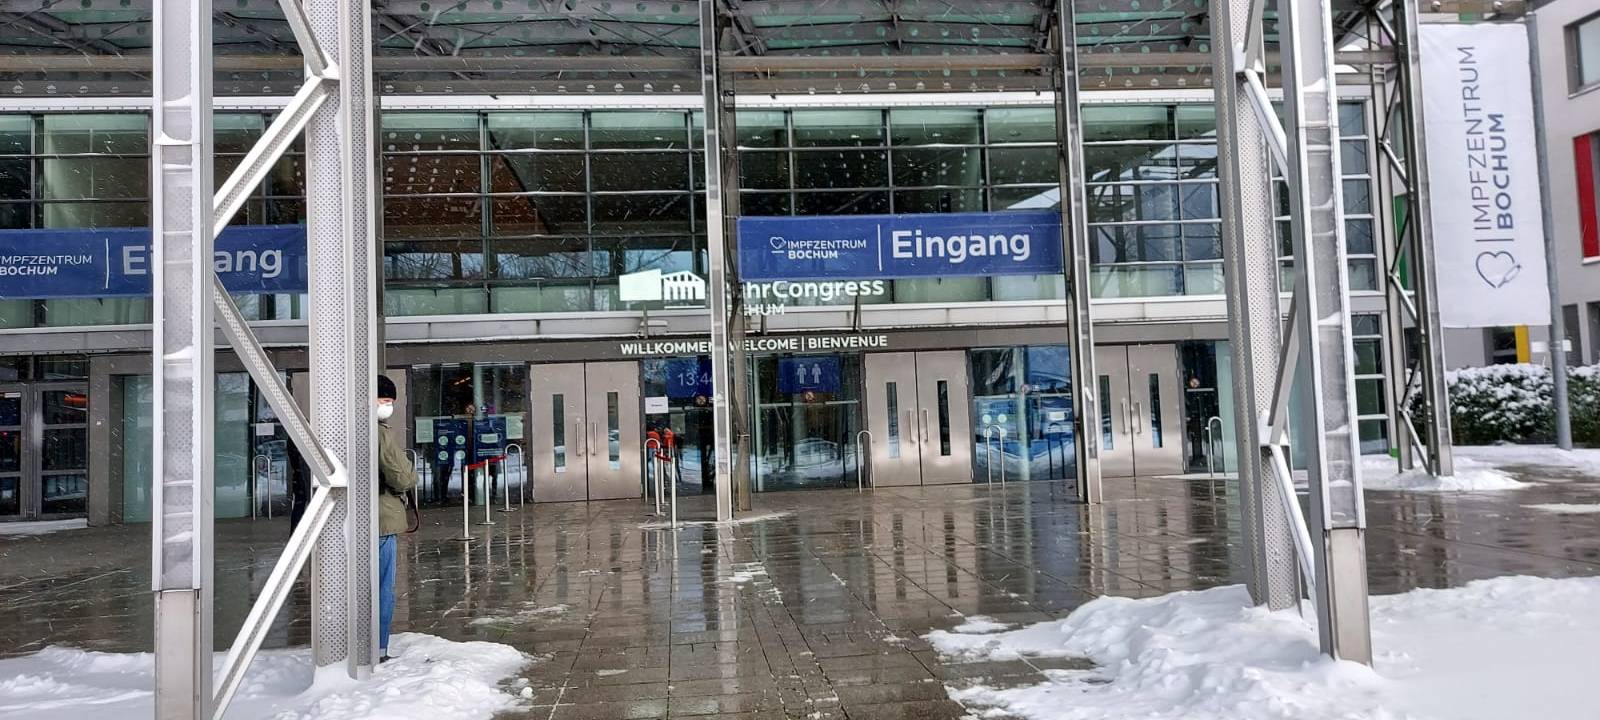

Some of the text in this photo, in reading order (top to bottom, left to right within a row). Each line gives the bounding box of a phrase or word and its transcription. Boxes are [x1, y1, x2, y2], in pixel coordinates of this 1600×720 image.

[1457, 46, 1491, 231] IMPFZENTRUM
[1488, 113, 1514, 230] BOCHUM
[787, 239, 867, 250] IMPFZENTRUM
[788, 249, 838, 260] BOCHUM
[891, 229, 1031, 263] Eingang
[0, 255, 92, 265] MPFZENTRUM
[123, 245, 282, 278] Eang
[726, 279, 885, 301] hrCongress
[808, 335, 888, 349] BIENVENUE
